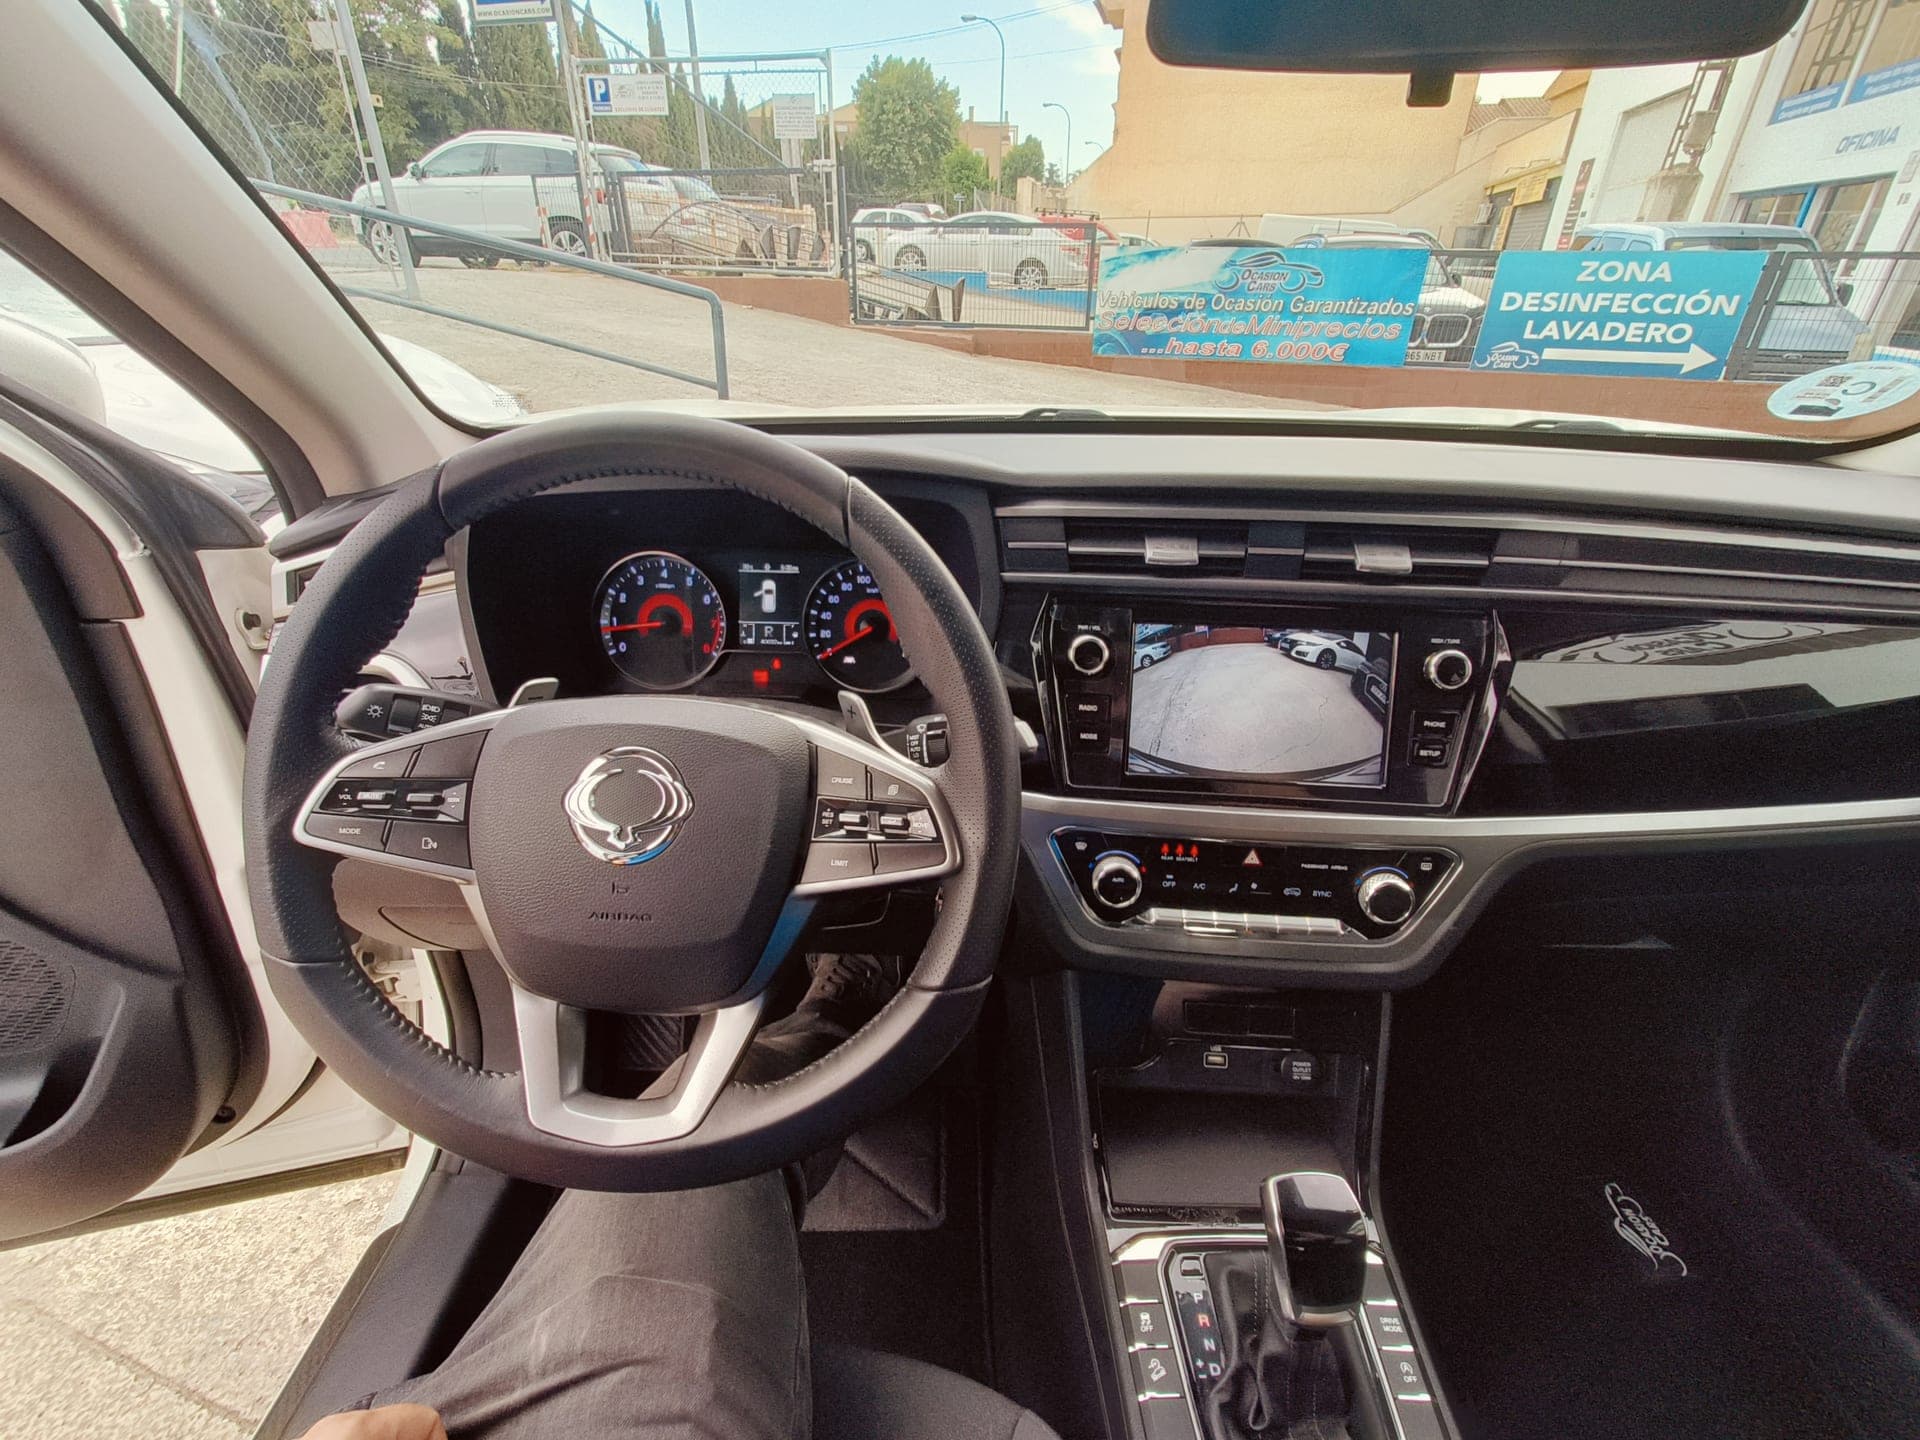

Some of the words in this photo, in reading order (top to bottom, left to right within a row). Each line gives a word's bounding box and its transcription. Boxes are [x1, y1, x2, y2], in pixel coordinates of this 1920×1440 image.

[1835, 125, 1902, 154] OFICINA
[1241, 268, 1289, 281] OCASION
[1576, 260, 1673, 283] ZONA
[1247, 280, 1277, 292] CARS
[1184, 292, 1206, 310] de
[1211, 293, 1283, 314] Ocasión
[1290, 295, 1415, 317] Garantizados
[1499, 288, 1741, 316] DESINFECCIÓN
[1523, 319, 1694, 344] LAVADERO
[1251, 339, 1350, 363] 6.000€
[661, 568, 668, 579] 4
[637, 575, 645, 586] 3
[856, 575, 871, 584] 100
[821, 611, 832, 620] 40
[764, 626, 774, 638] R
[820, 630, 831, 639] 20
[1078, 703, 1098, 711] RADIO
[1423, 720, 1446, 729] PHONE
[1419, 749, 1441, 757] SETUP
[831, 777, 854, 785] CRUISE
[830, 859, 849, 867] LIMIT
[1193, 882, 1206, 890] A/C
[1312, 890, 1333, 898] SYNC
[587, 911, 653, 922] AIRBAG
[1193, 1292, 1203, 1304] P
[1197, 1313, 1210, 1328] R
[1140, 1325, 1154, 1333] OFF
[1203, 1338, 1216, 1352] N
[1208, 1362, 1221, 1377] D
[1403, 1375, 1418, 1384] OFF
